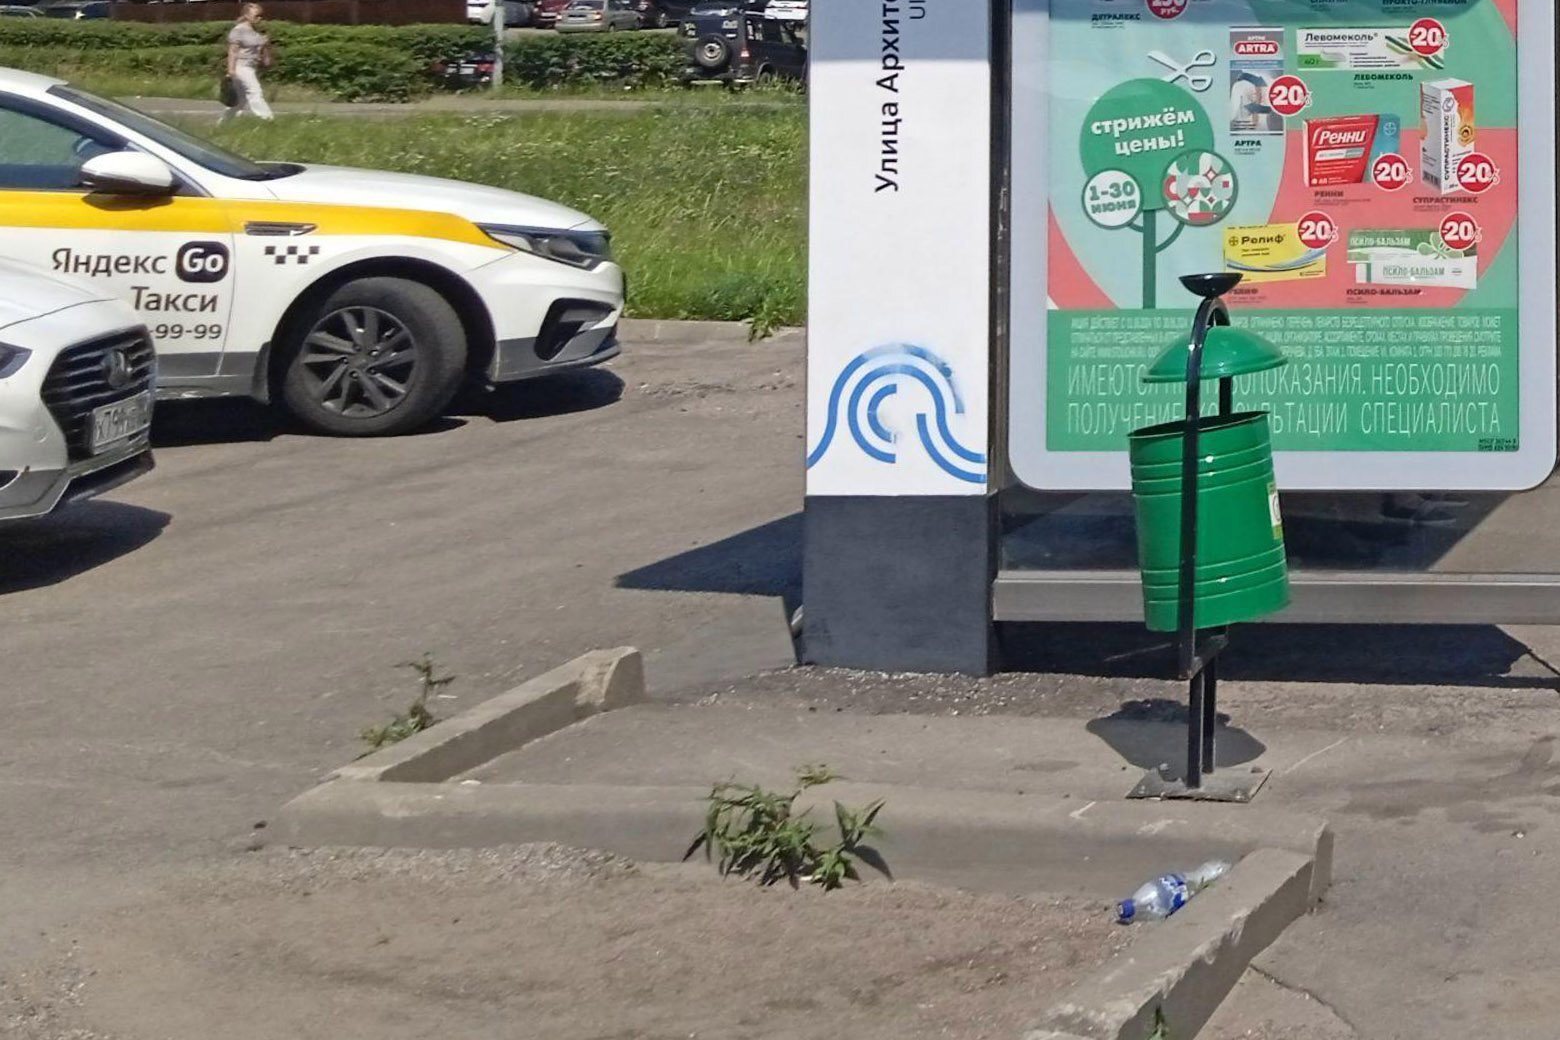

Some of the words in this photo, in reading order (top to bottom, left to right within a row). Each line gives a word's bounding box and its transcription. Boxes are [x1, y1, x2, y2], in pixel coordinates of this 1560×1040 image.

[1353, 73, 1414, 81] ЛЕВОМЕКОЛЬ
[1091, 107, 1195, 137] стрижём
[875, 102, 902, 193] Улица
[1115, 129, 1185, 156] цены!
[1318, 130, 1366, 145] Ренни
[1089, 180, 1136, 201] 1-30
[52, 247, 167, 277] Яндекс
[182, 247, 225, 273] Go
[130, 285, 218, 313] Такси
[1372, 363, 1500, 399] НЕОБХОДИМО
[1361, 402, 1500, 438] СПЕЦИАЛИСТА
